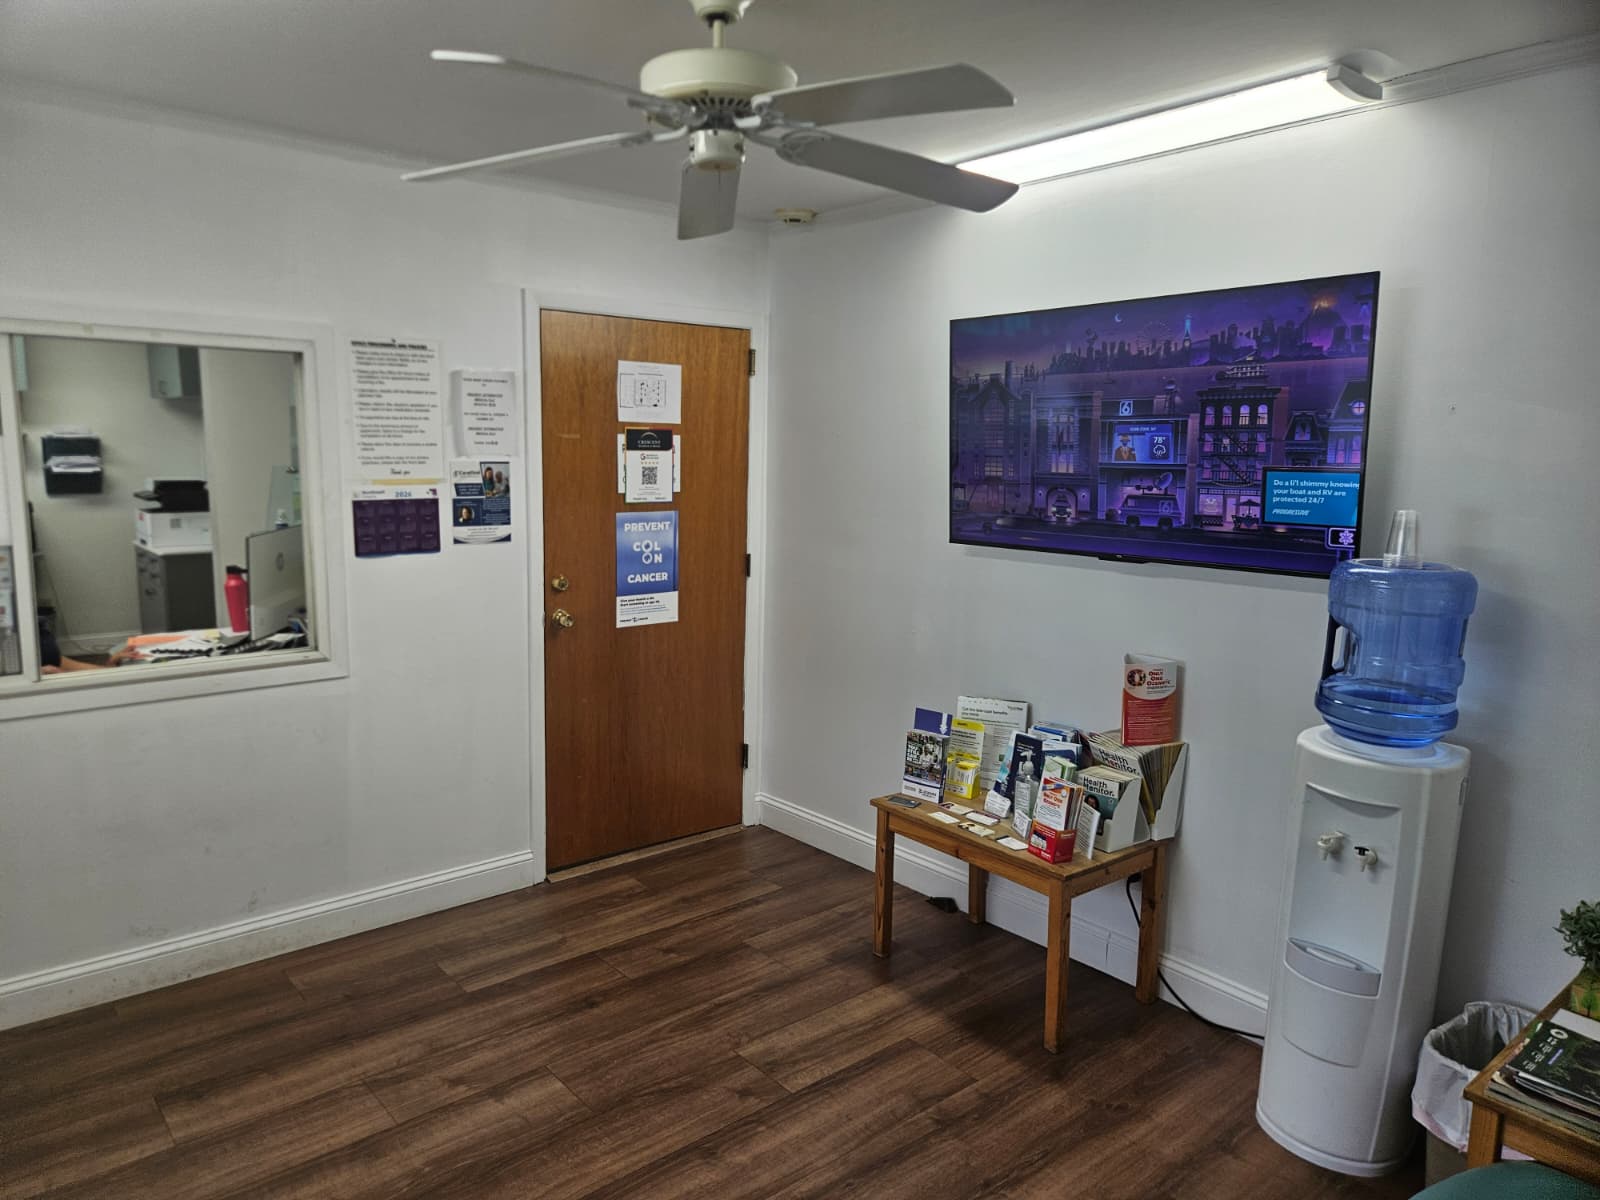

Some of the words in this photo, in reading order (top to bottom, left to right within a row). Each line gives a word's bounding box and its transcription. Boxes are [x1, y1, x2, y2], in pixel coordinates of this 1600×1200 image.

[1122, 401, 1131, 414] 6
[1300, 480, 1328, 488] shimmy
[1329, 481, 1360, 490] knowing
[1289, 487, 1306, 495] boat
[1272, 496, 1307, 504] protected
[1272, 508, 1310, 516] PROGRESSIVE
[624, 521, 671, 532] PREVENT
[627, 572, 668, 583] CANCER
[1099, 749, 1129, 766] Health
[1083, 776, 1108, 789] Health
